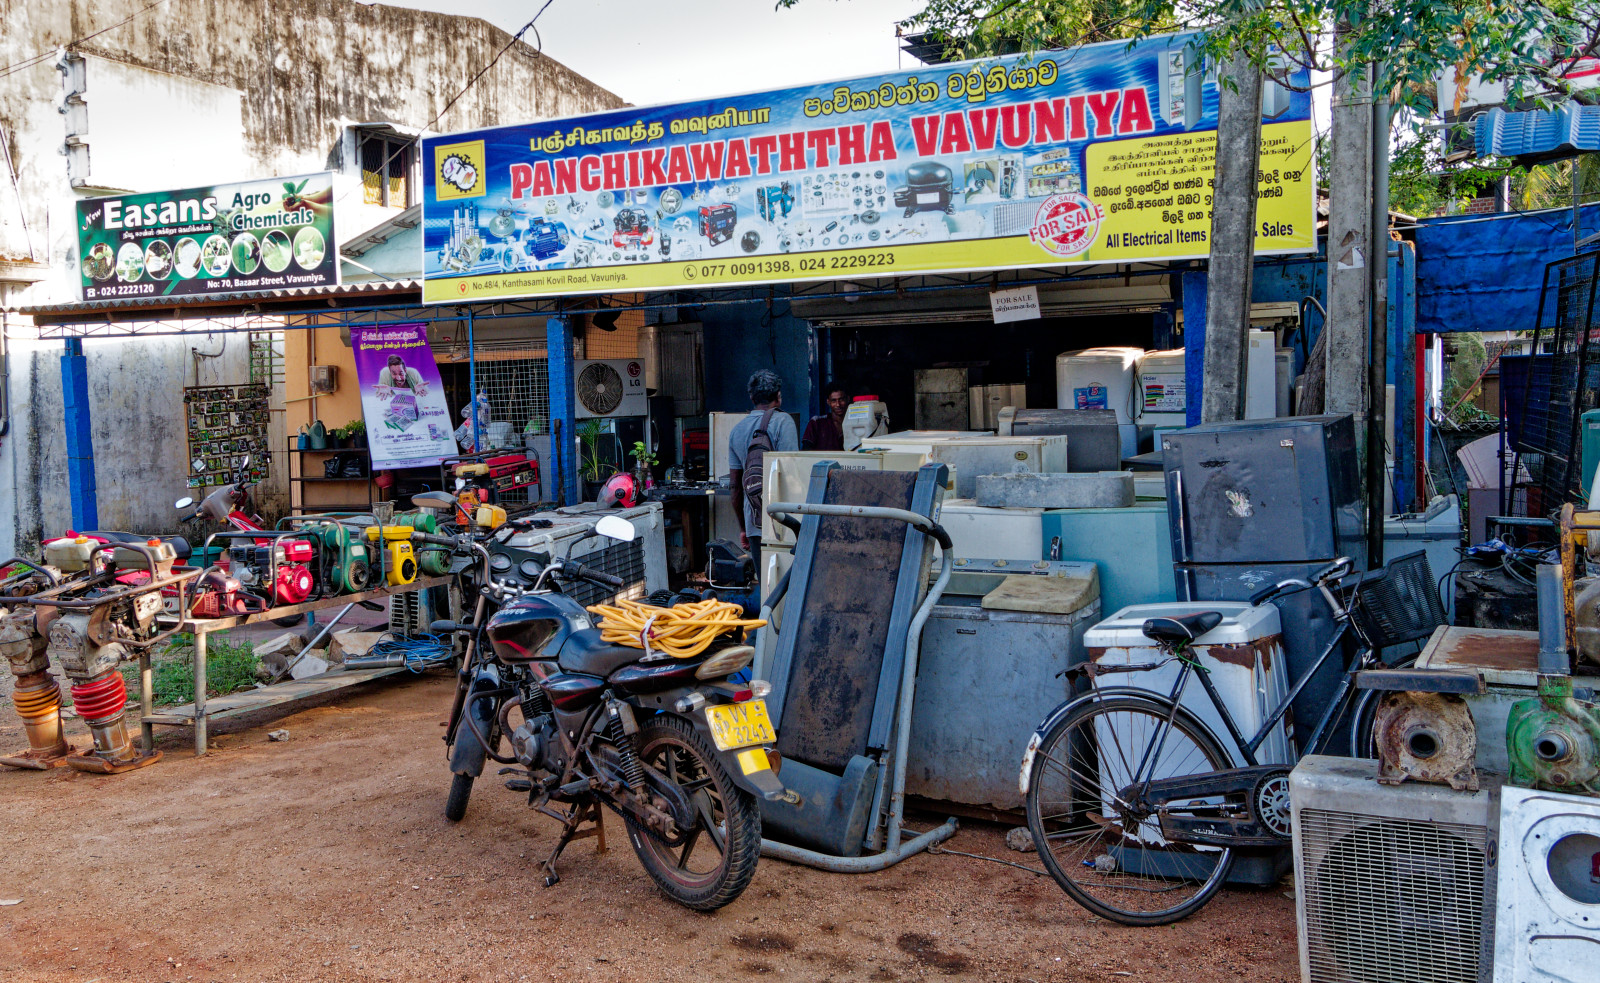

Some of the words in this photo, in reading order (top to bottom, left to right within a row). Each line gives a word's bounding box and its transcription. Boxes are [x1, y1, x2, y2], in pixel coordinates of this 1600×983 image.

[804, 77, 939, 117] පංචිකාවත්ත
[948, 60, 1058, 102] වවුනියාව
[530, 119, 664, 153] பஞ்சிகாவத்த
[670, 106, 771, 134] வவுனியா
[510, 120, 897, 200] PANCHIKAWATHTHA
[911, 87, 1154, 157] VAVUNIYA
[1094, 185, 1121, 197] ඔබගේ
[82, 208, 102, 231] New
[104, 197, 217, 230] Easans
[232, 192, 271, 211] Agro
[1044, 200, 1057, 212] FOR
[1058, 195, 1076, 203] SALE
[232, 207, 313, 231] Chemicals
[1029, 220, 1061, 242] FOR
[1063, 204, 1105, 230] SALE
[1106, 234, 1120, 249] All
[1122, 230, 1173, 247] Electrical
[1176, 228, 1207, 243] Items
[1262, 221, 1293, 237] Sales
[1073, 234, 1090, 249] SALE
[701, 265, 726, 277] 077
[731, 261, 794, 276] 0091398,
[800, 257, 826, 271] 024
[831, 253, 895, 269] 2229223
[101, 286, 117, 296] 024
[118, 284, 154, 296] 2222120
[207, 279, 220, 288] No:
[221, 279, 233, 289] 70,
[234, 277, 259, 287] Bazaar
[261, 275, 285, 286] Street,
[286, 273, 326, 286] Vavuniya.
[472, 280, 500, 291] No.48/4,
[502, 276, 544, 288] Kanthasami
[547, 274, 566, 285] Kovil
[567, 274, 588, 285] Road,
[591, 272, 628, 284] Vavuniya.
[1013, 294, 1033, 303] SALE
[630, 379, 641, 387] LG
[728, 705, 749, 723] VY
[733, 723, 769, 743] 3241
